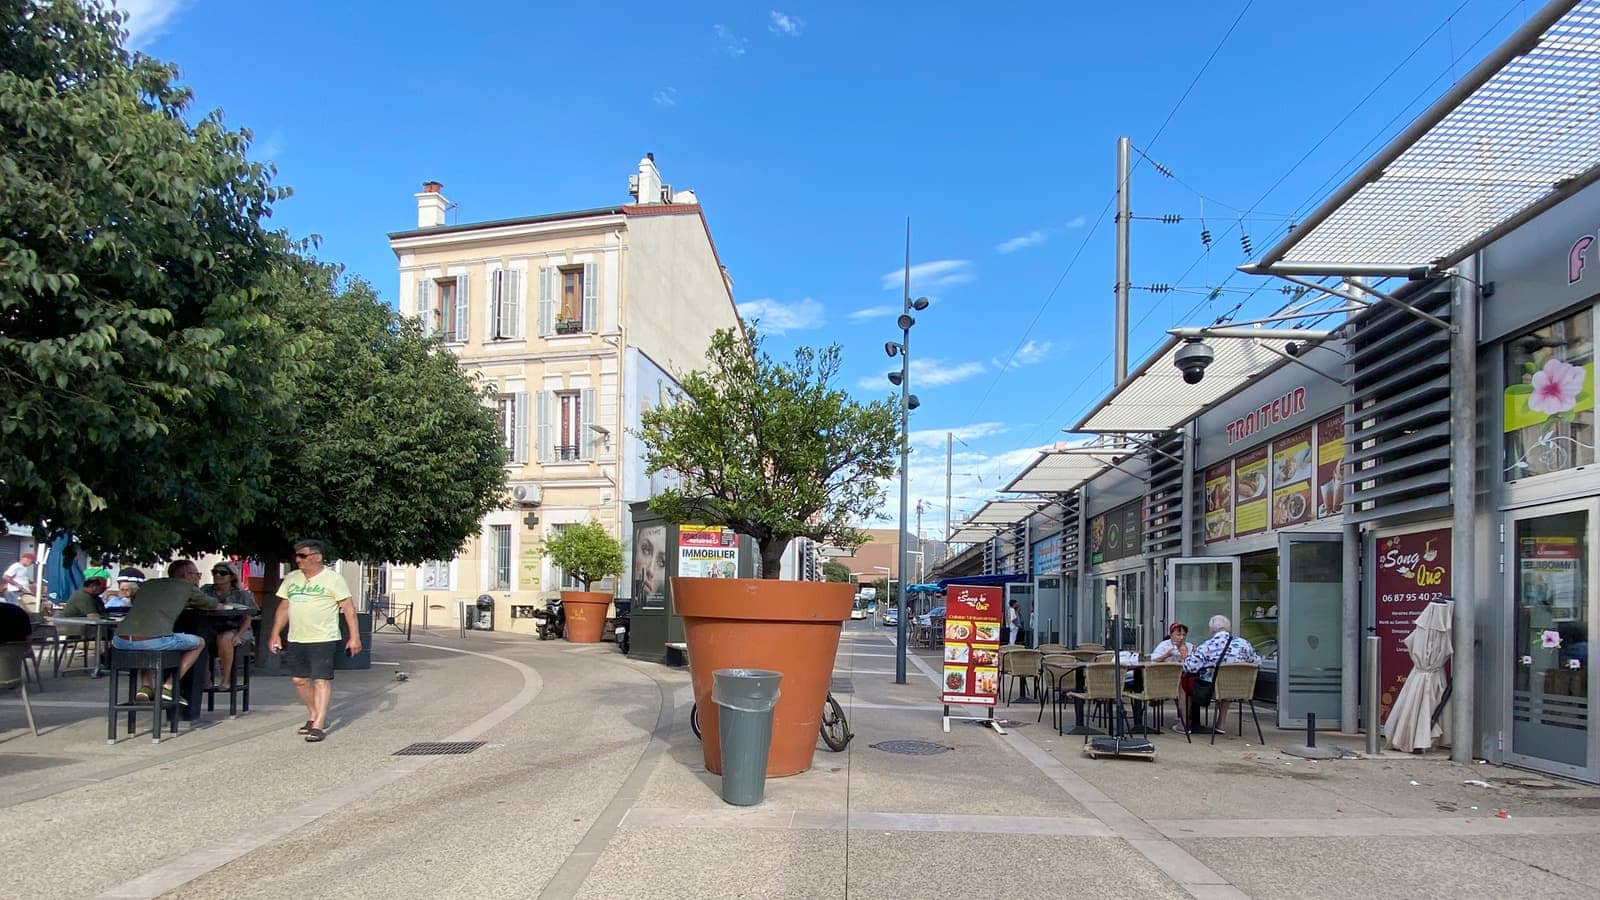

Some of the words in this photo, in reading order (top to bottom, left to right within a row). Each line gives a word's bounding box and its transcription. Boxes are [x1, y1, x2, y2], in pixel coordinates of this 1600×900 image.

[1226, 386, 1306, 446] TRAITEUR
[682, 549, 736, 559] IMMOBILIER
[1384, 549, 1420, 570] Song
[1382, 594, 1393, 602] 06
[1394, 593, 1405, 602] 87
[1406, 593, 1417, 601] 95
[1418, 592, 1430, 601] 40
